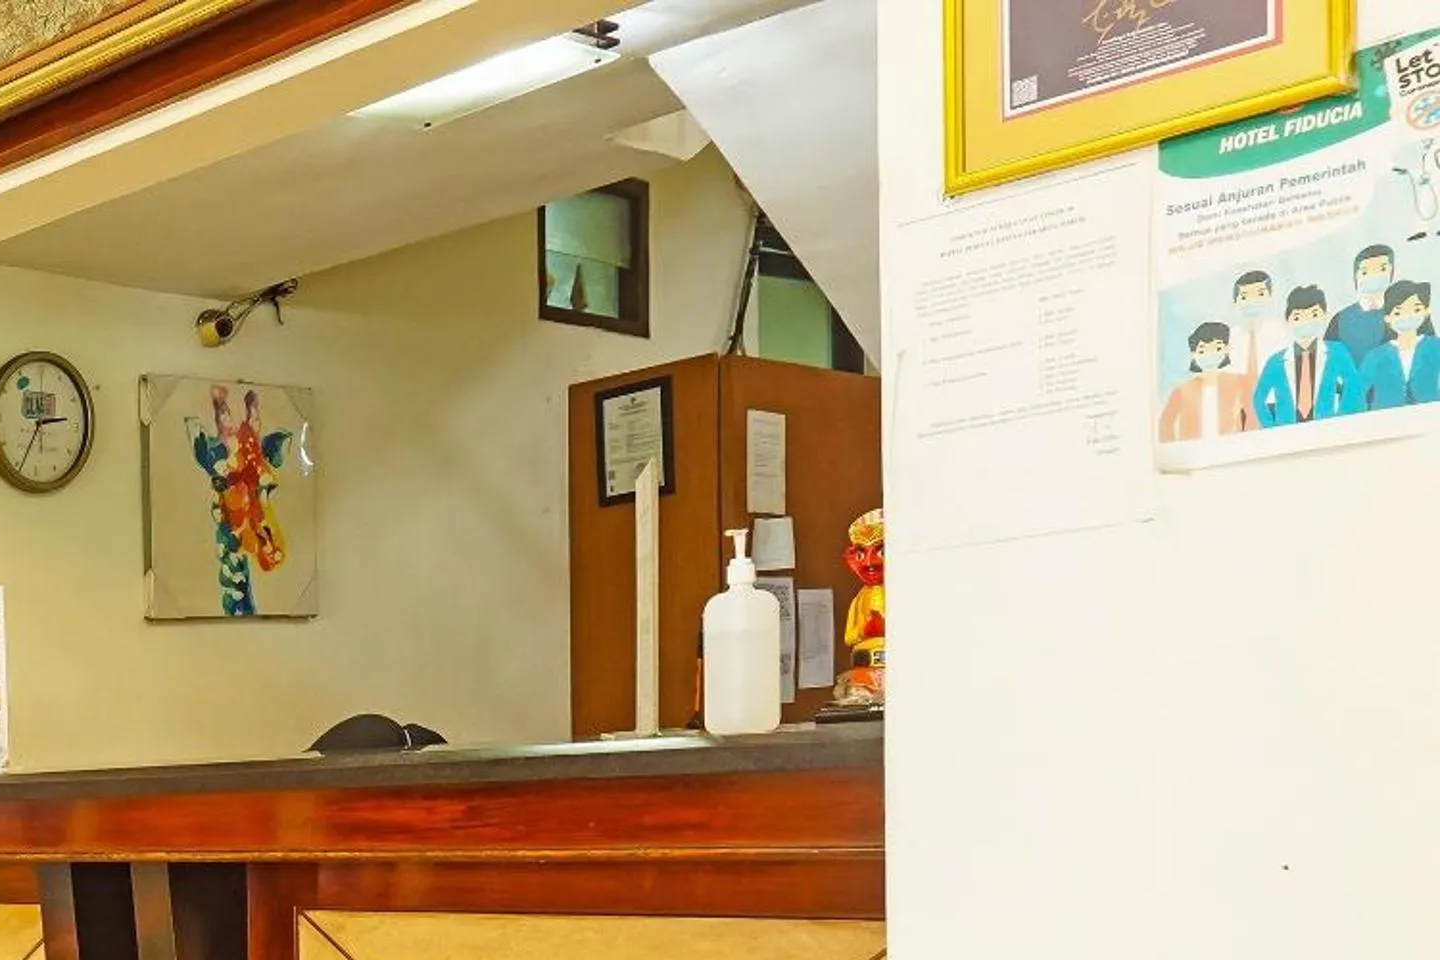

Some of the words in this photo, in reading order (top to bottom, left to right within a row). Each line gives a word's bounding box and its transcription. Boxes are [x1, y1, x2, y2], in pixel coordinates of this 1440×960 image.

[1399, 63, 1440, 89] STO
[1219, 125, 1280, 154] HOTEL
[1284, 101, 1363, 137] FIDUCIA
[1166, 193, 1213, 216] Sesuai
[1217, 182, 1275, 208] Anjuran
[1279, 159, 1366, 190] Pemerintah
